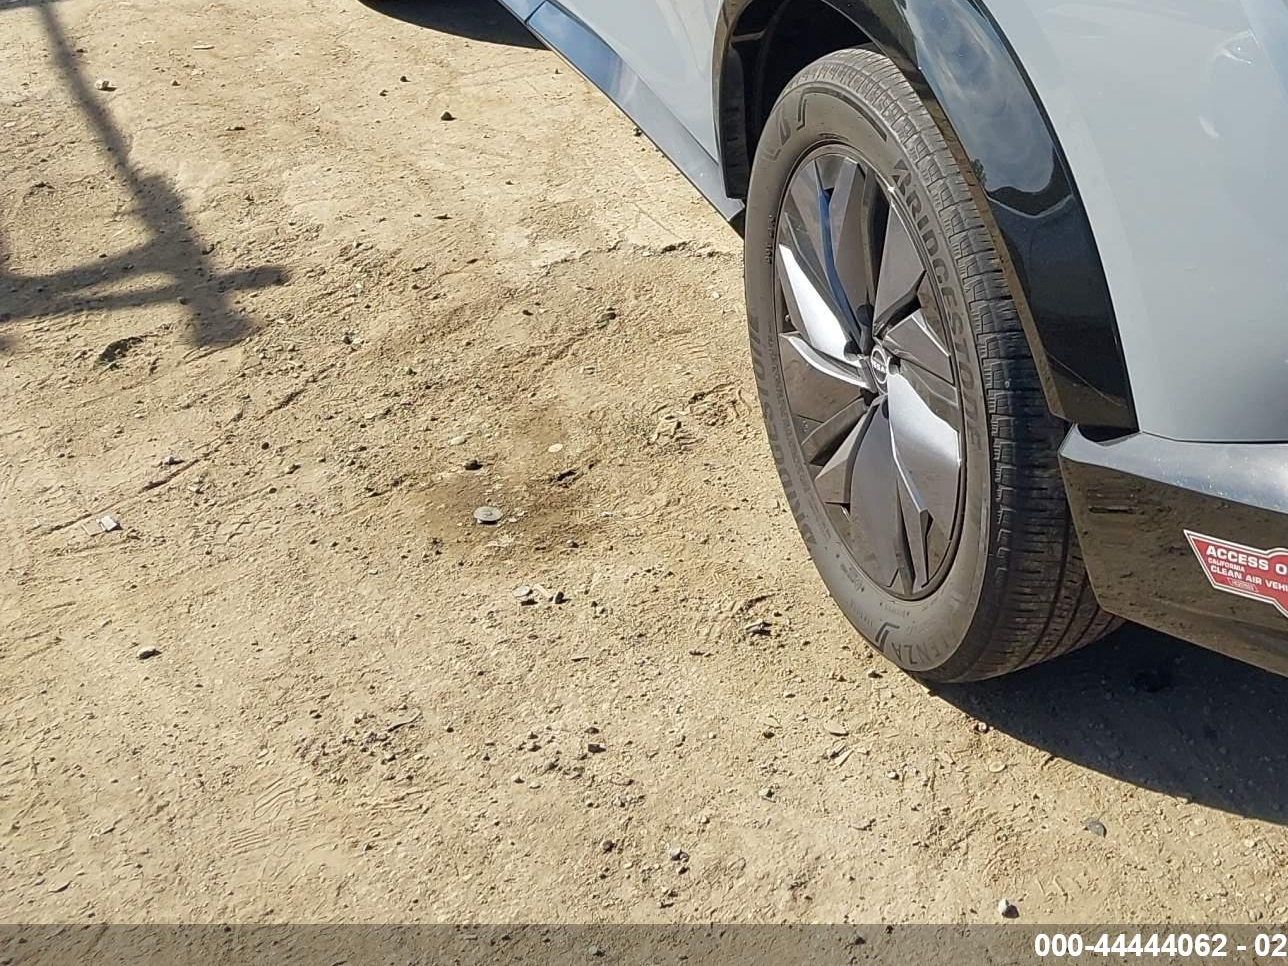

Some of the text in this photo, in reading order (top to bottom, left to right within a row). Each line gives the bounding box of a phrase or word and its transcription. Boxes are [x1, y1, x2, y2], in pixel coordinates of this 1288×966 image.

[1206, 545, 1269, 571] ACCESS
[1207, 557, 1246, 573] CALIFORNIA
[1210, 565, 1242, 580] CLEAN
[1245, 574, 1262, 586] AIR
